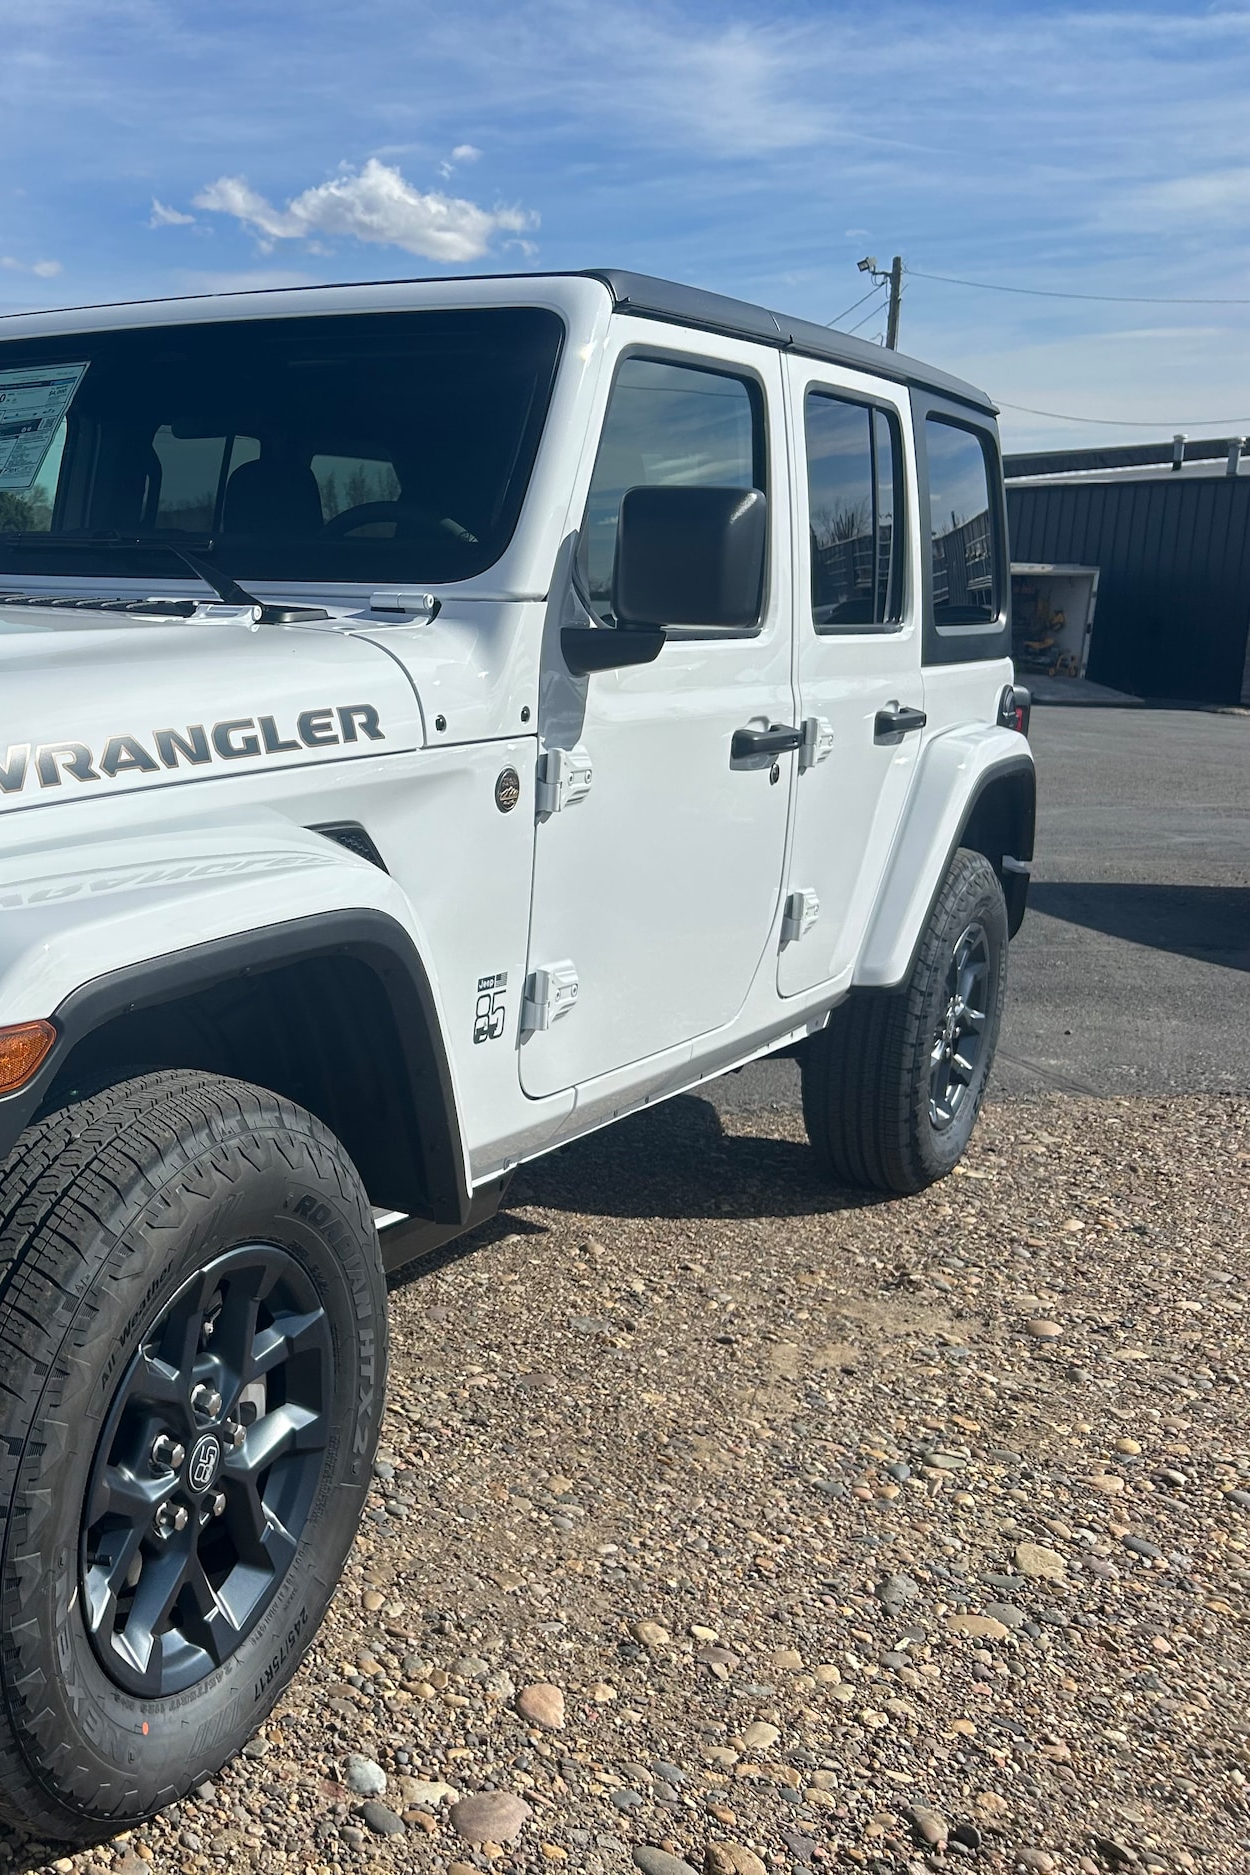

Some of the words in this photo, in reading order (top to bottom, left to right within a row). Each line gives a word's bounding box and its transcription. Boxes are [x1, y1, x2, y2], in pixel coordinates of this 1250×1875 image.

[473, 989, 507, 1045] 85
[478, 978, 494, 990] Jeep
[100, 1354, 117, 1390] All
[119, 1259, 174, 1348] Weather
[293, 1194, 372, 1319] ROADIAN
[357, 1328, 375, 1419] HTX
[254, 1606, 310, 1702] 245/75R17
